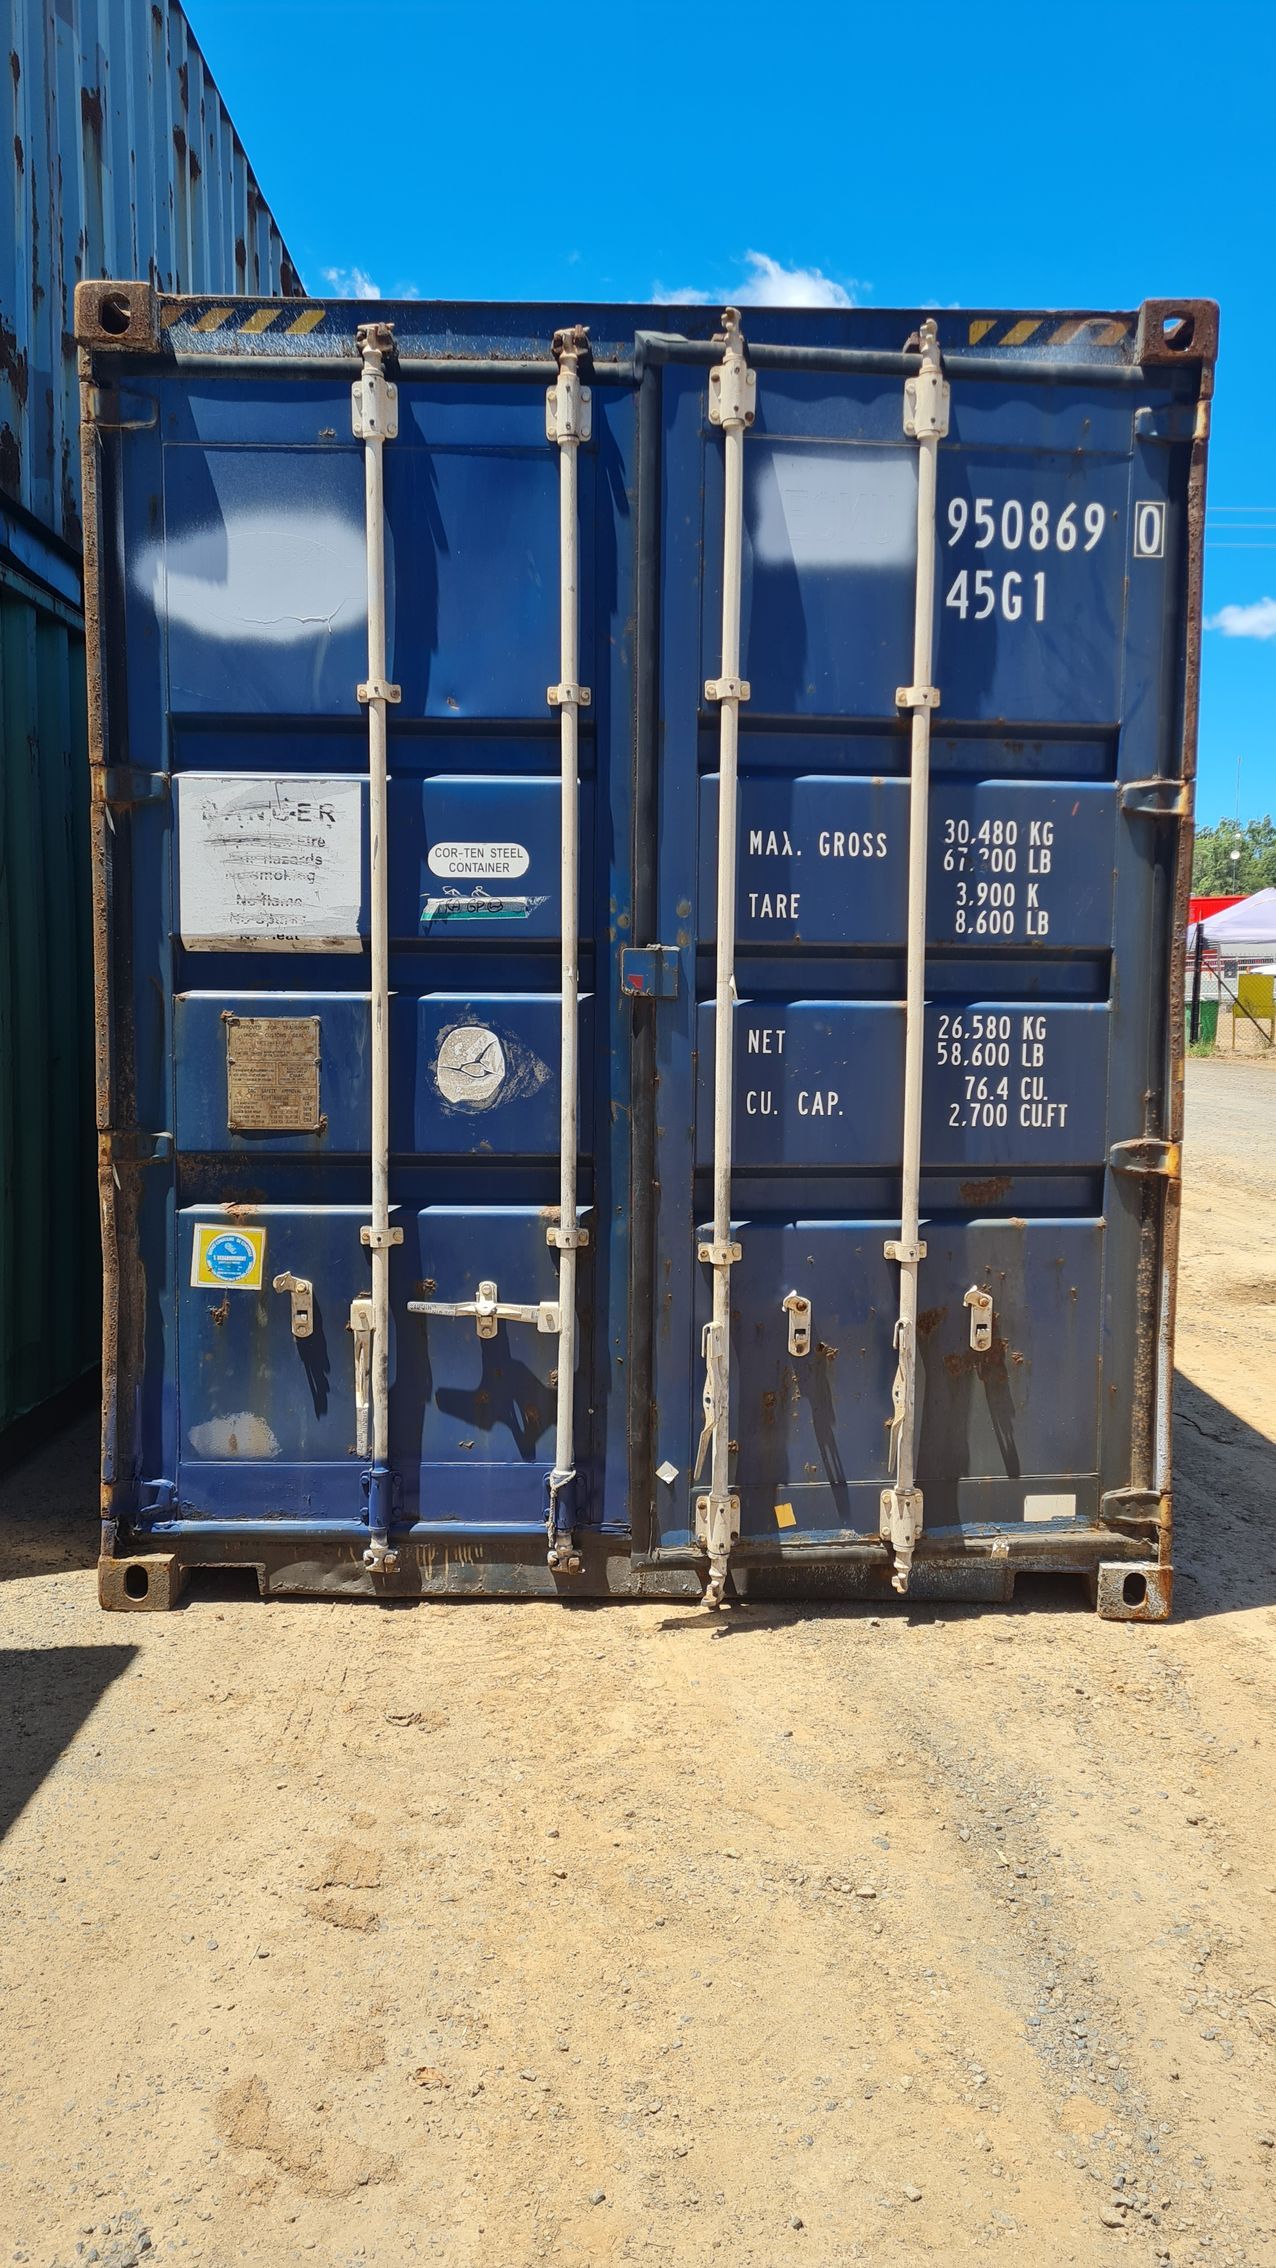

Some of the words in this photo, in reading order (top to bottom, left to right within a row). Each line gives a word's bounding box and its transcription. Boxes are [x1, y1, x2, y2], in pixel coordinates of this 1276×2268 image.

[948, 497, 1106, 552] 950869
[1138, 505, 1161, 554] 0
[946, 569, 1045, 622] 45G1
[202, 799, 336, 822] GER
[749, 830, 802, 856] MAX.
[819, 831, 887, 858] GROSS
[944, 819, 1018, 846] 30,480
[1029, 820, 1054, 847] KG
[435, 847, 485, 859] COR-TEN
[489, 848, 524, 859] STEEL
[1028, 848, 1052, 874] LB
[448, 862, 510, 873] CONTAINER
[748, 893, 801, 919] TARE
[956, 881, 1016, 907] 3,900
[1027, 883, 1039, 908] K
[955, 909, 1015, 935] 8,600
[1026, 910, 1049, 936] LB
[938, 1014, 1011, 1040] 26,580
[1022, 1015, 1047, 1041] KG
[748, 1029, 786, 1054] NET
[937, 1041, 1010, 1067] 58,600
[1021, 1042, 1044, 1068] LB
[964, 1075, 1009, 1101] 76.4
[1020, 1076, 1048, 1101] CU.
[746, 1090, 778, 1115] CU.
[797, 1091, 843, 1116] CAP.
[948, 1102, 1008, 1127] 2,700
